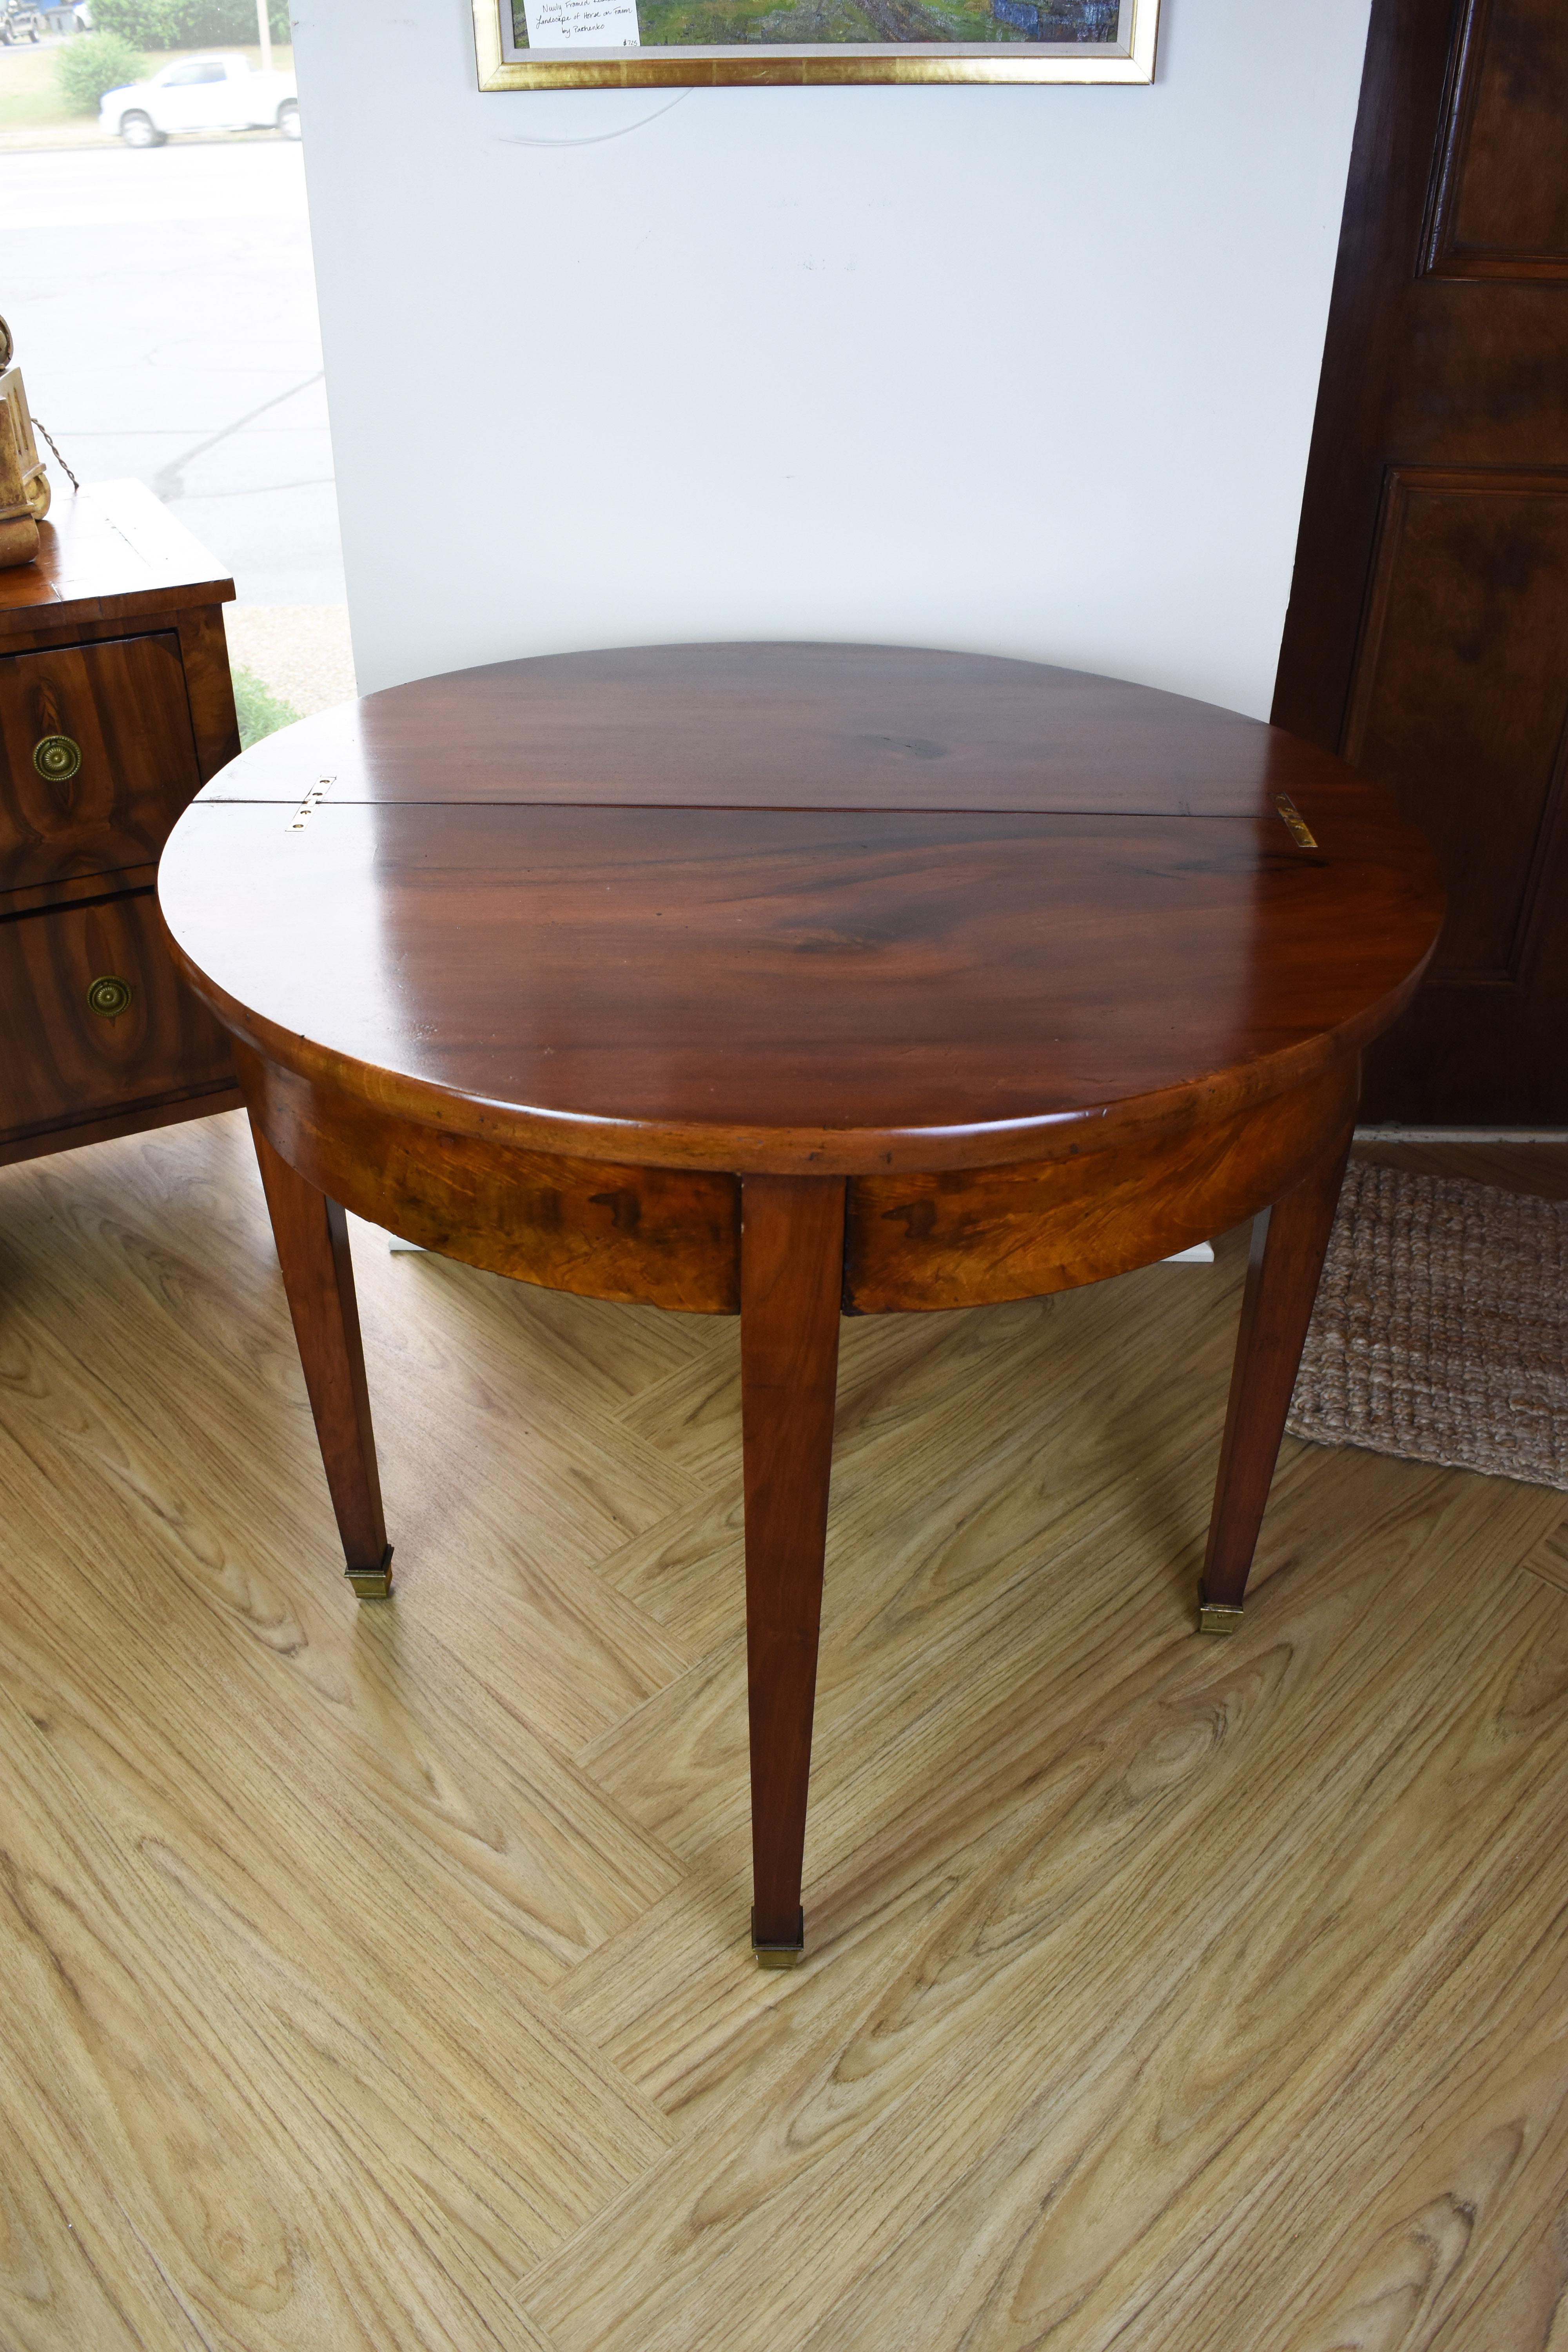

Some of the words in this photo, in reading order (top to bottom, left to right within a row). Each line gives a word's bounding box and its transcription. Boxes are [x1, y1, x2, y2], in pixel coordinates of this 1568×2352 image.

[543, 3, 562, 17] Newly
[536, 15, 571, 29] Landscape
[613, 6, 632, 15] Farm
[561, 27, 570, 38] by
